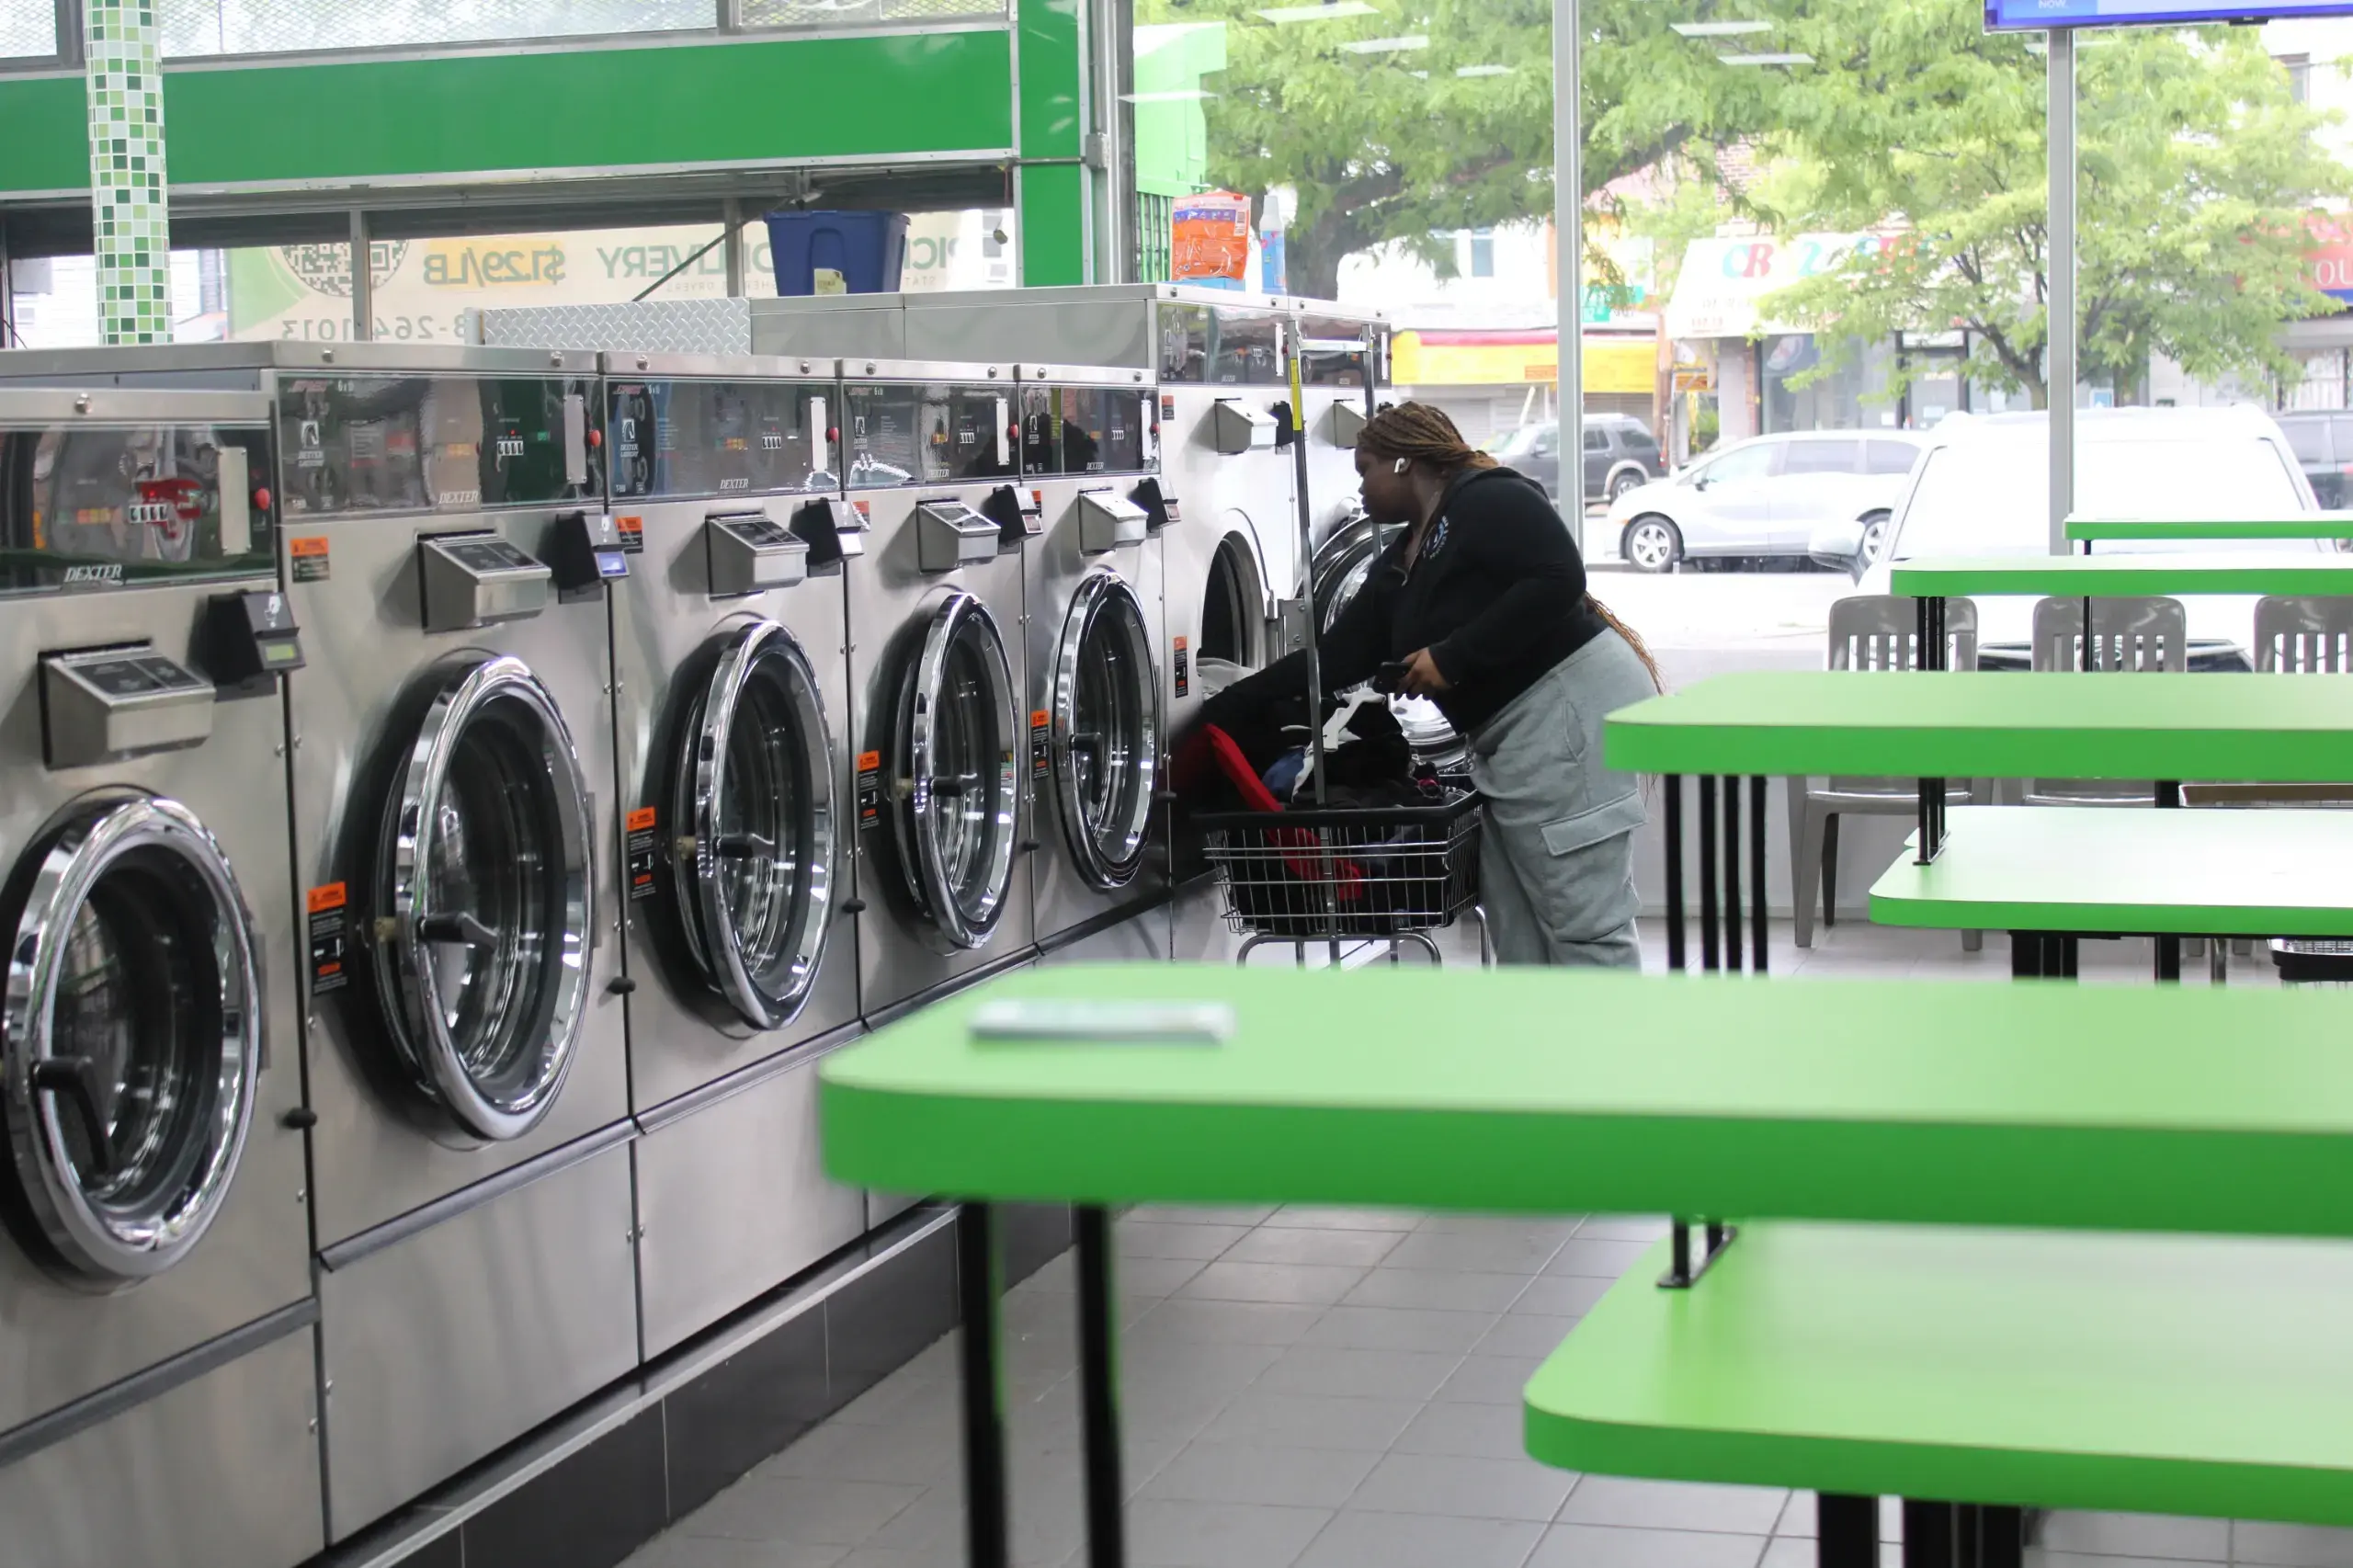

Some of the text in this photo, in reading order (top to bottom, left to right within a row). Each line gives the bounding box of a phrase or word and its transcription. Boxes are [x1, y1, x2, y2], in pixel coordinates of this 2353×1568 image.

[720, 478, 749, 490] DEXTER
[438, 490, 479, 505] DEXTER
[63, 563, 122, 584] DEXTER
